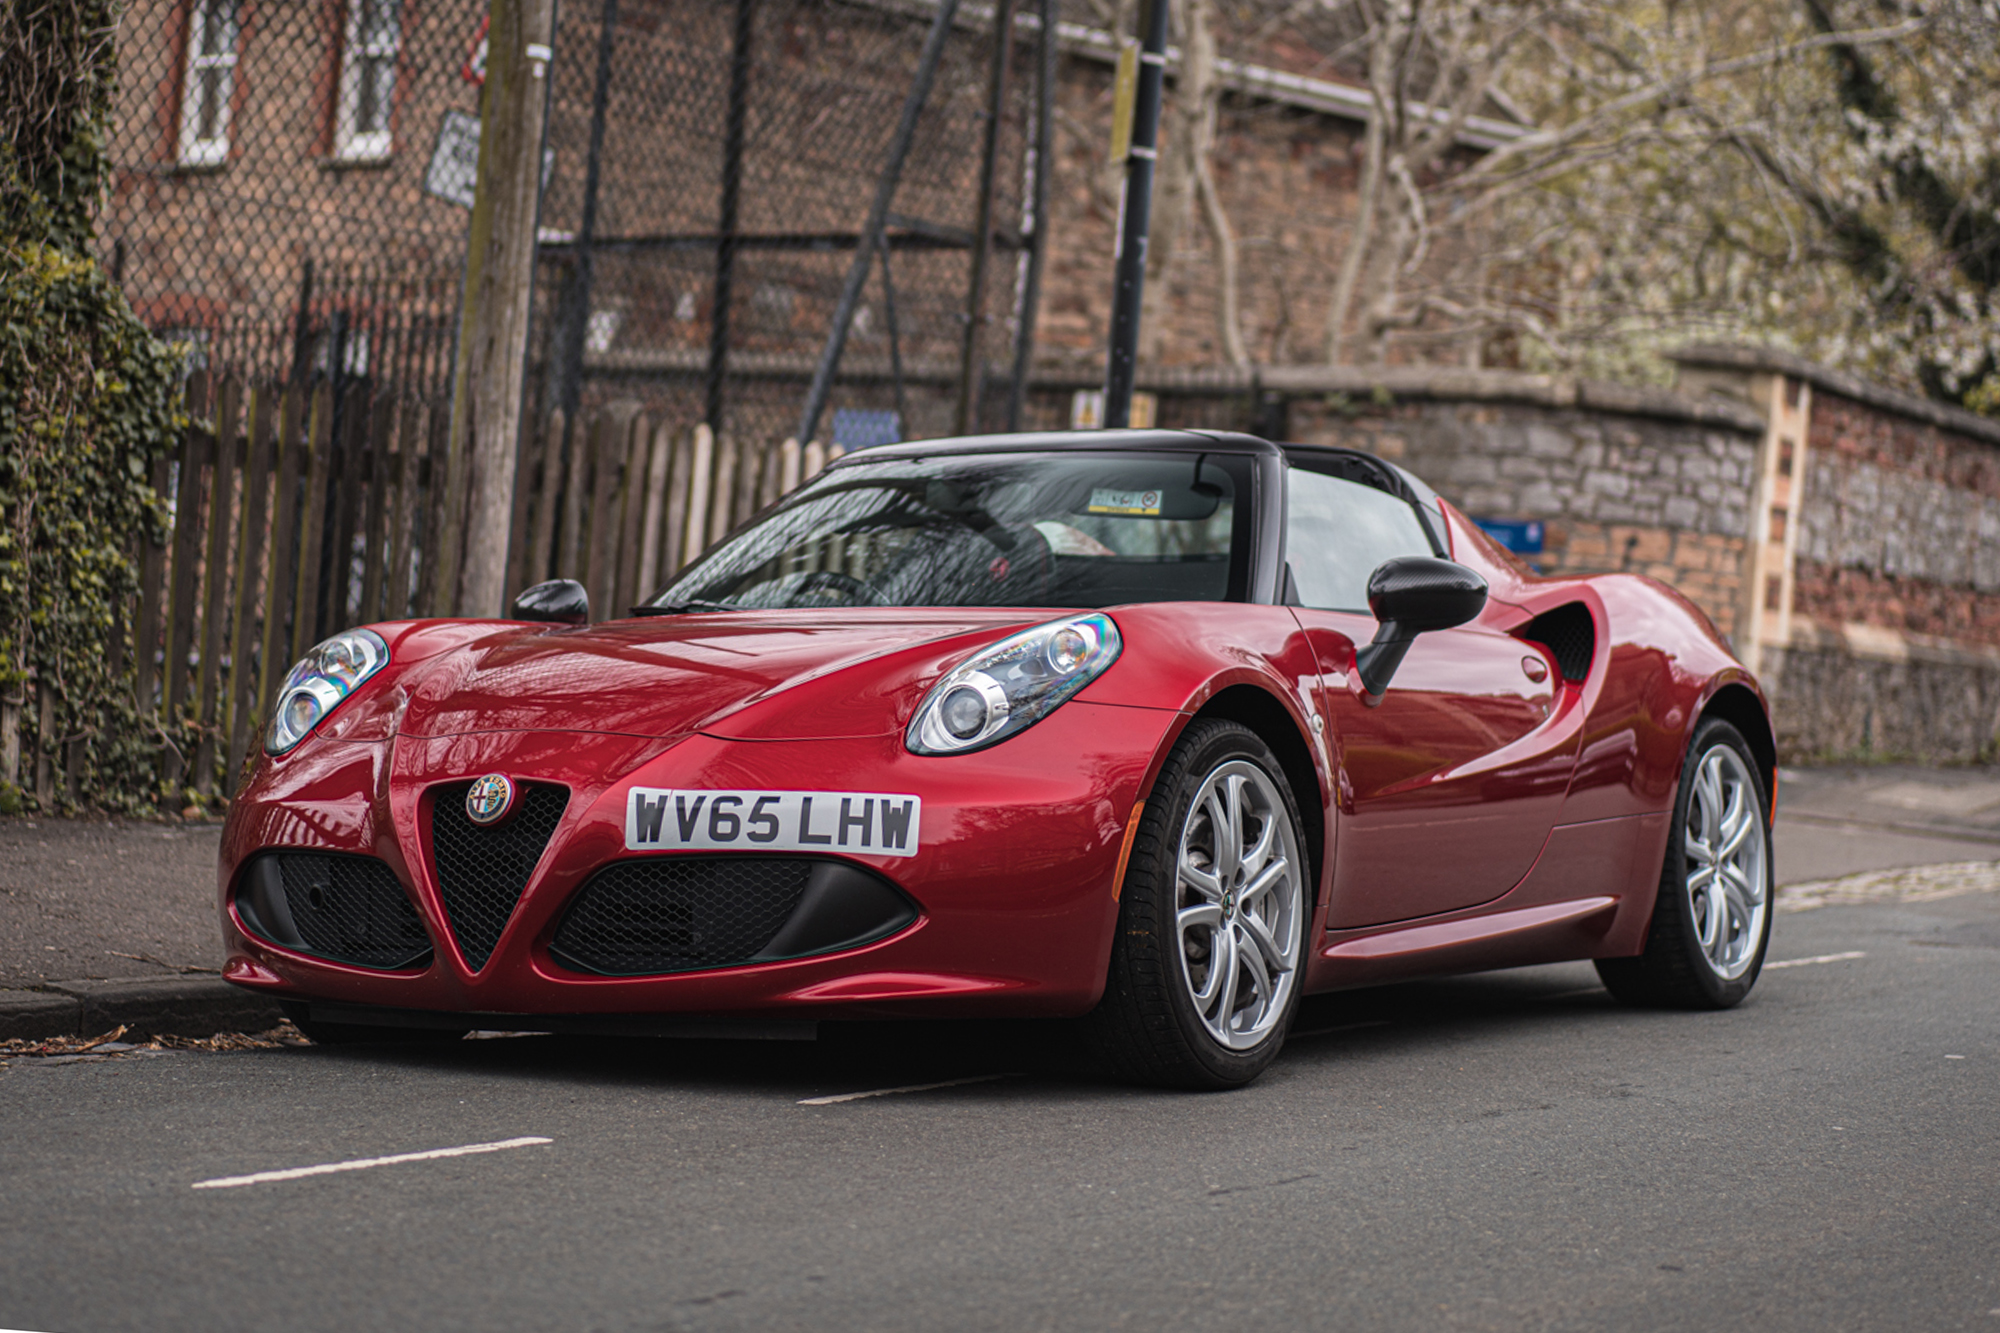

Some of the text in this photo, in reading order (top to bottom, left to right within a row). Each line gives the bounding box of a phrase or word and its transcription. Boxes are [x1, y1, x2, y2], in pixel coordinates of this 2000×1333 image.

[469, 776, 506, 800] ALFA ROMEO
[635, 793, 913, 849] WV65 LHW
